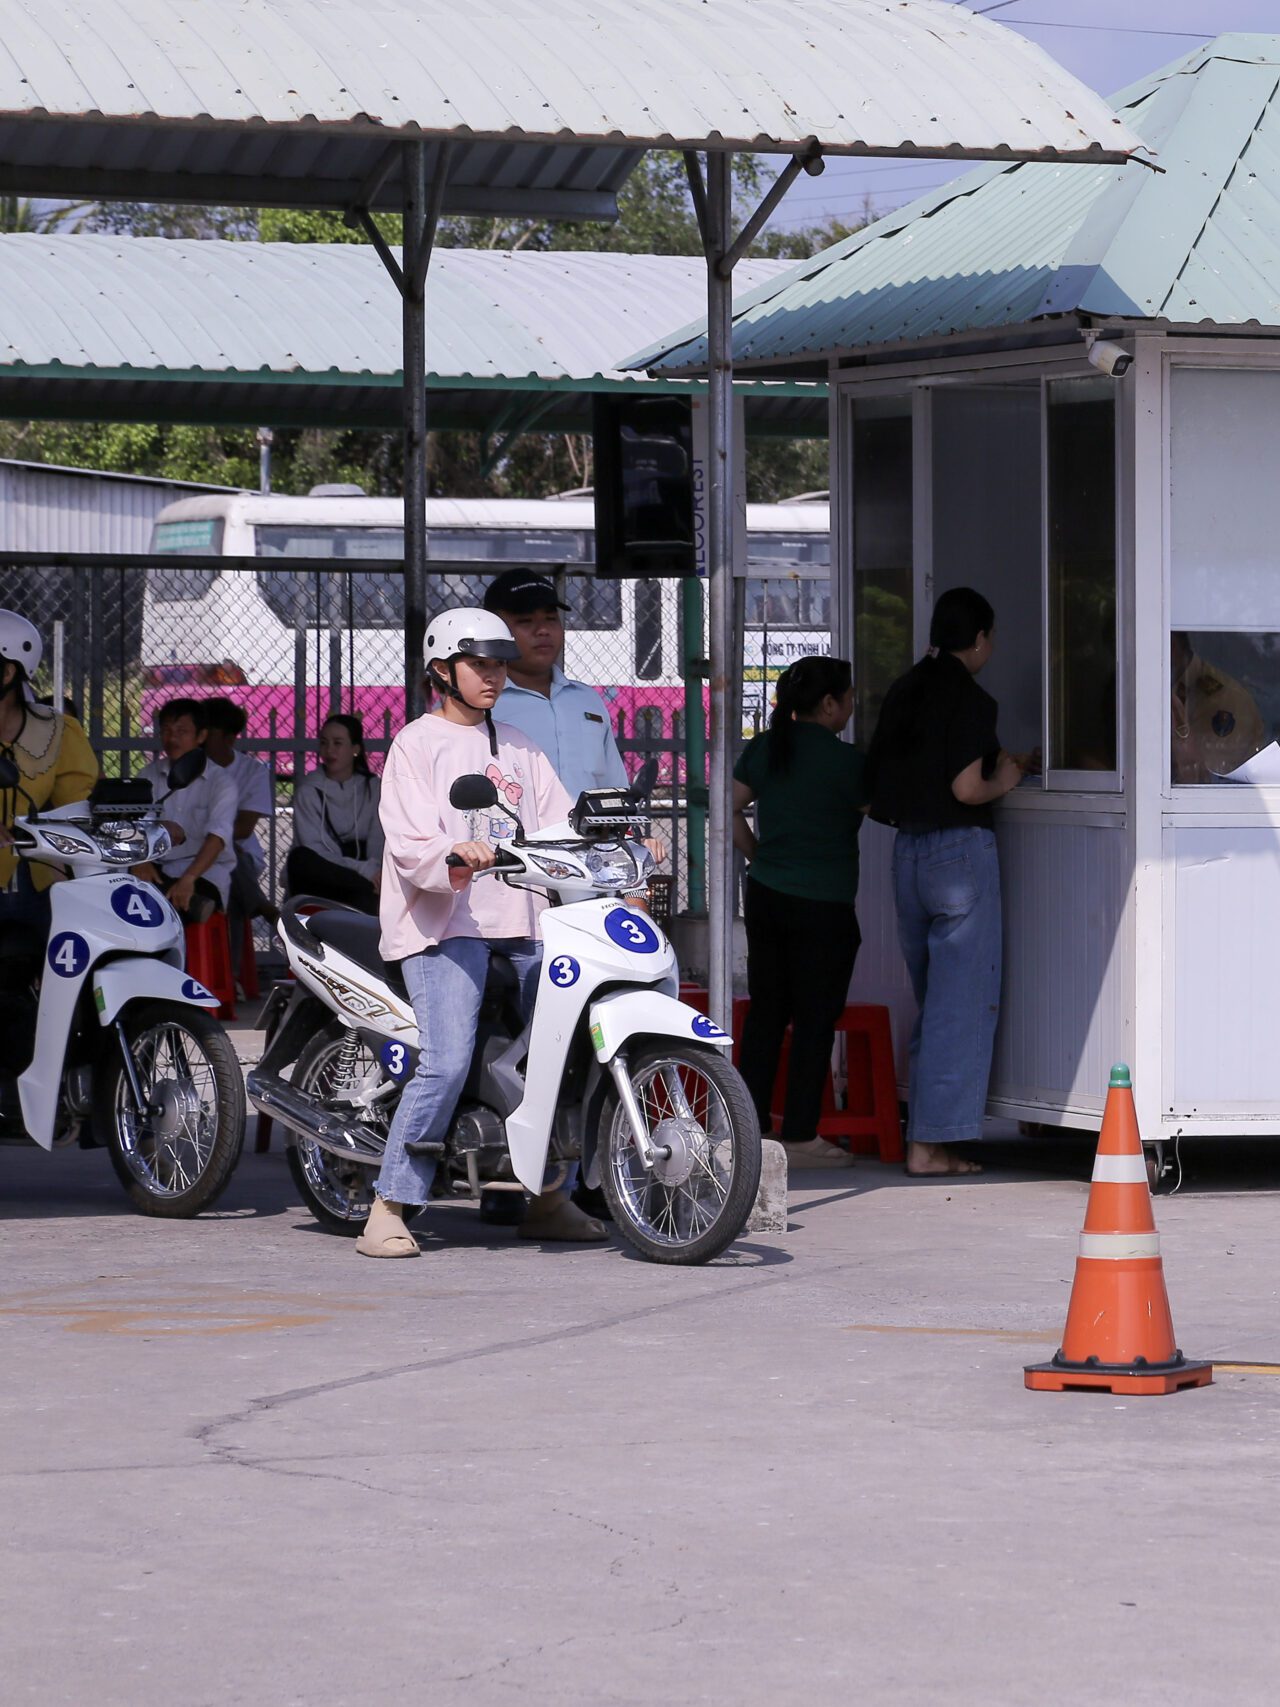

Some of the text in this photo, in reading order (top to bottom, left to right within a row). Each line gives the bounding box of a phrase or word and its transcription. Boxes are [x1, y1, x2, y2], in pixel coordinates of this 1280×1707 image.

[126, 893, 153, 921] 4
[620, 919, 647, 944] 3
[55, 939, 78, 973] 4
[553, 956, 575, 985] 3
[387, 1043, 405, 1075] 3
